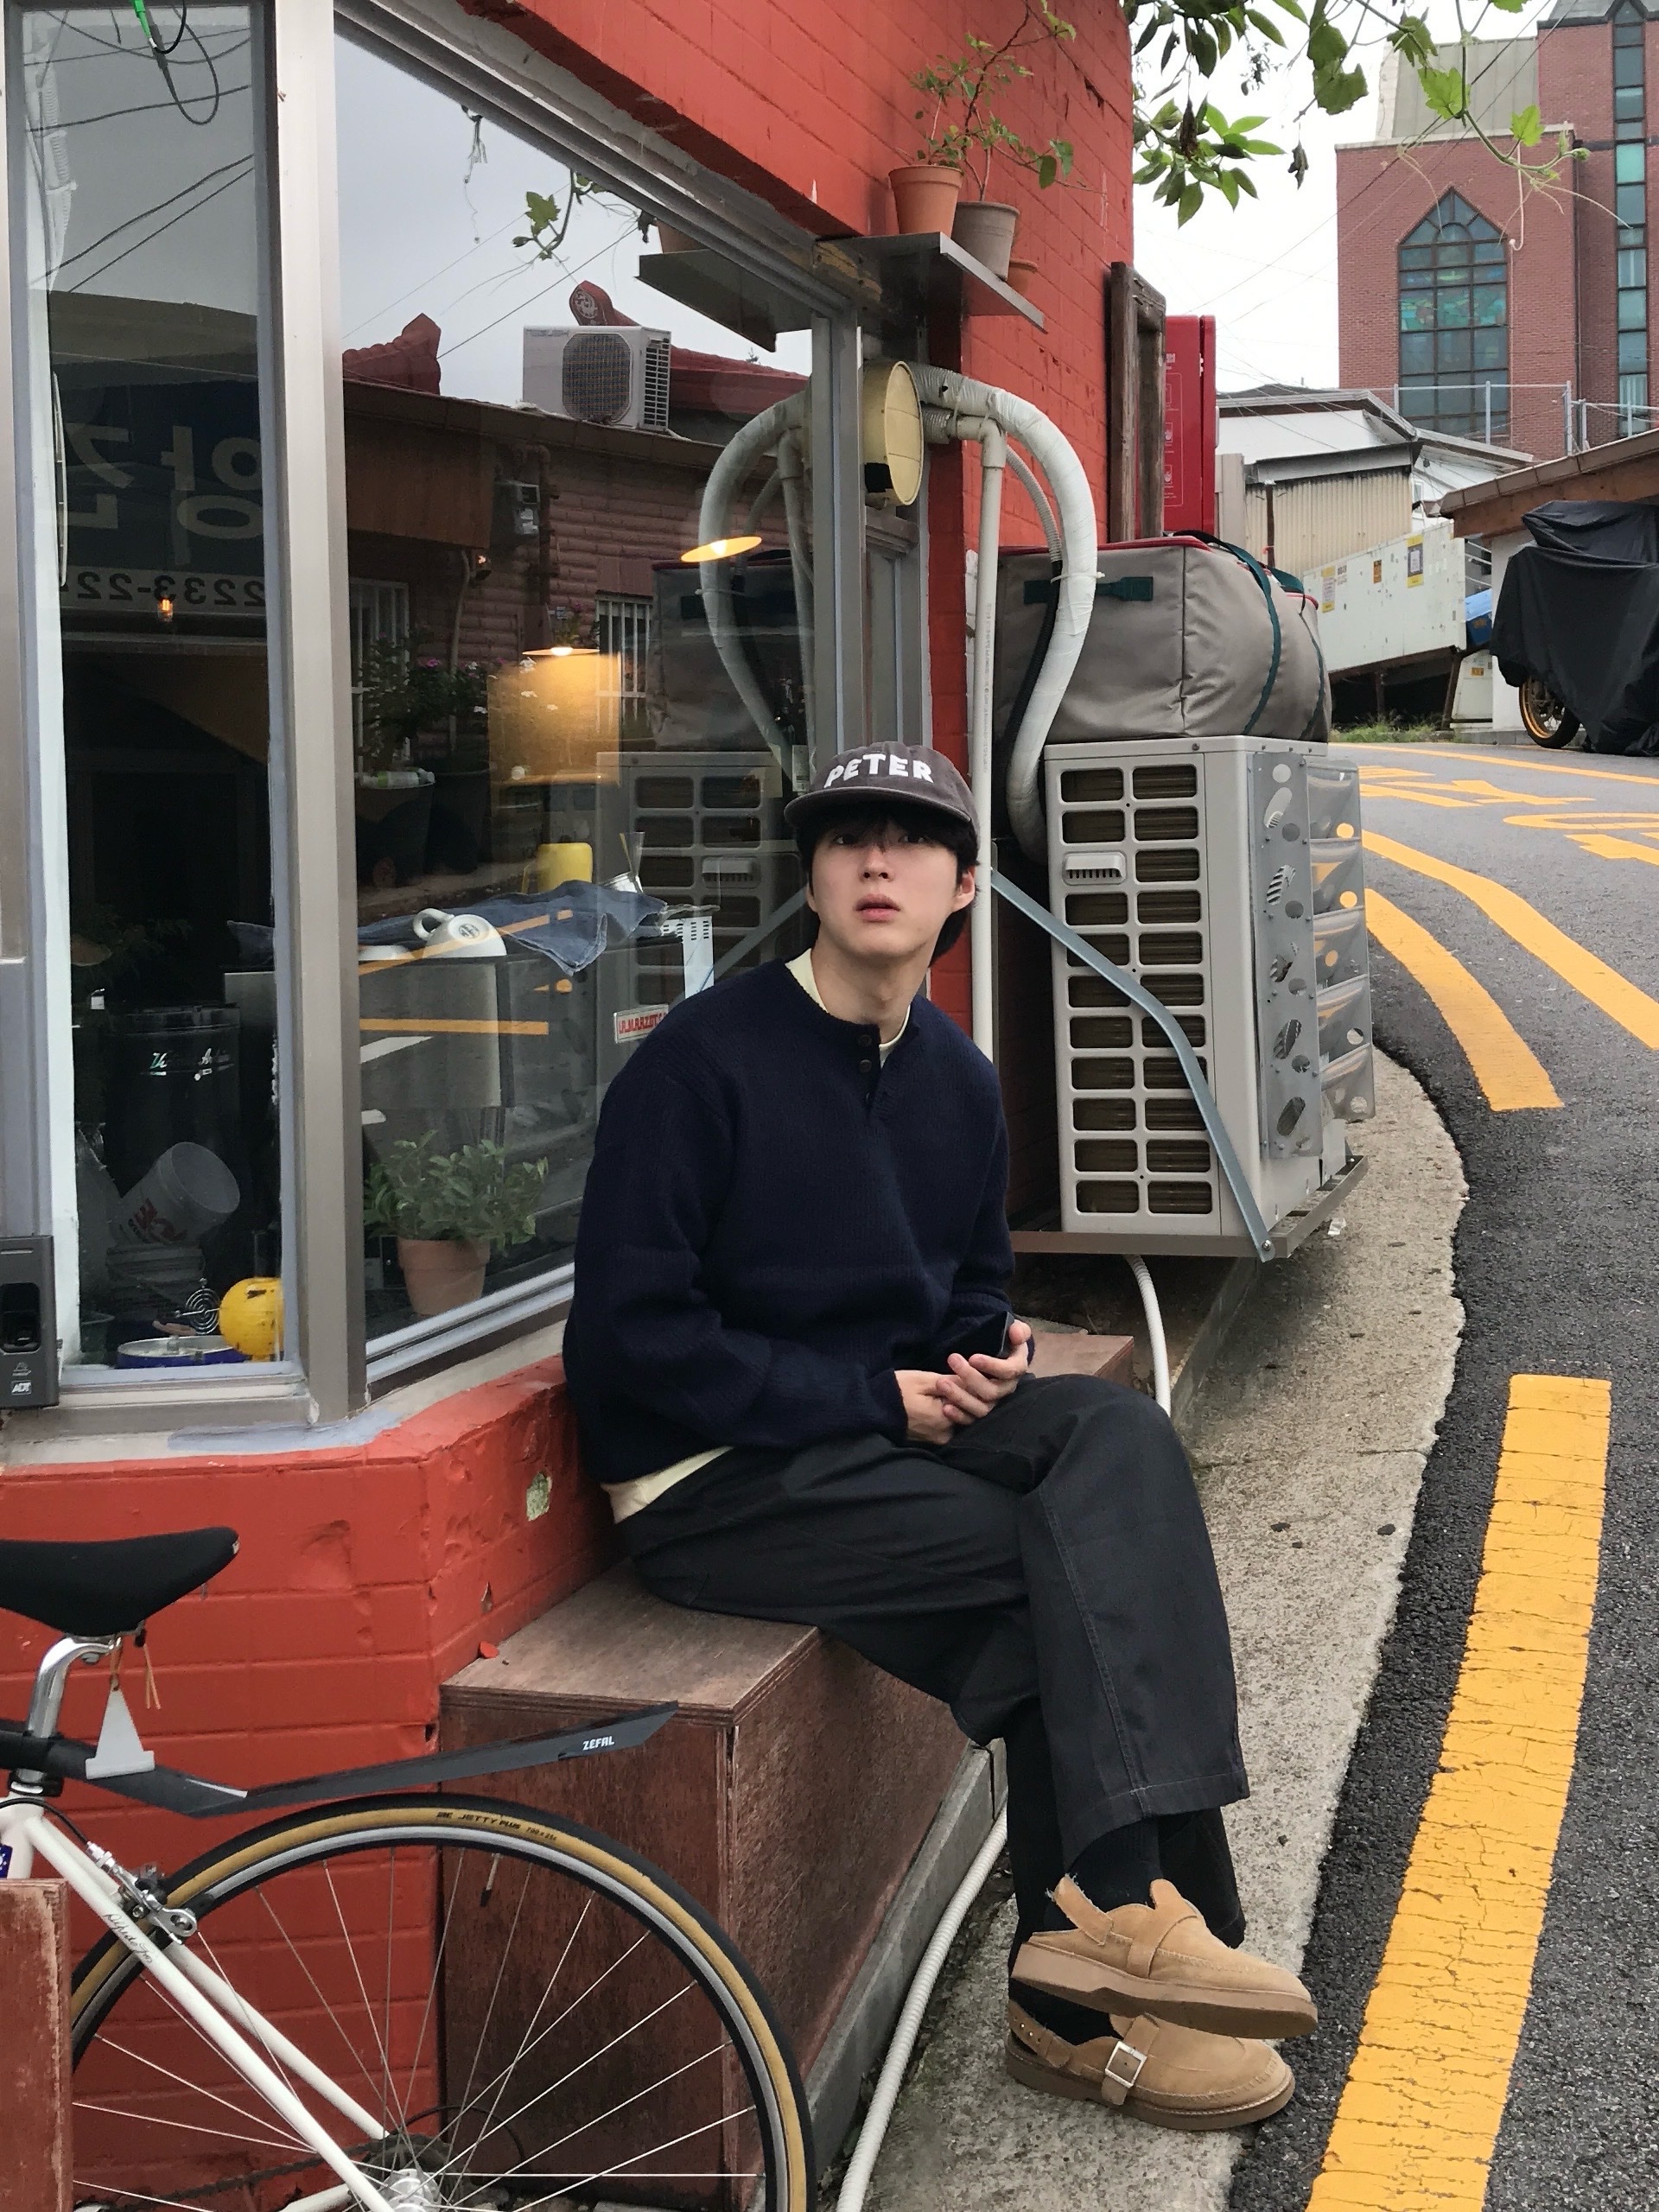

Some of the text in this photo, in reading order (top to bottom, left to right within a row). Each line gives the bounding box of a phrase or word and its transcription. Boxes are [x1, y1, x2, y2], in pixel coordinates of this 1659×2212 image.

[823, 753, 934, 789] PETER
[582, 1736, 615, 1751] ZEFAL
[459, 1814, 497, 1824] JETTY
[499, 1820, 521, 1829] PLUS
